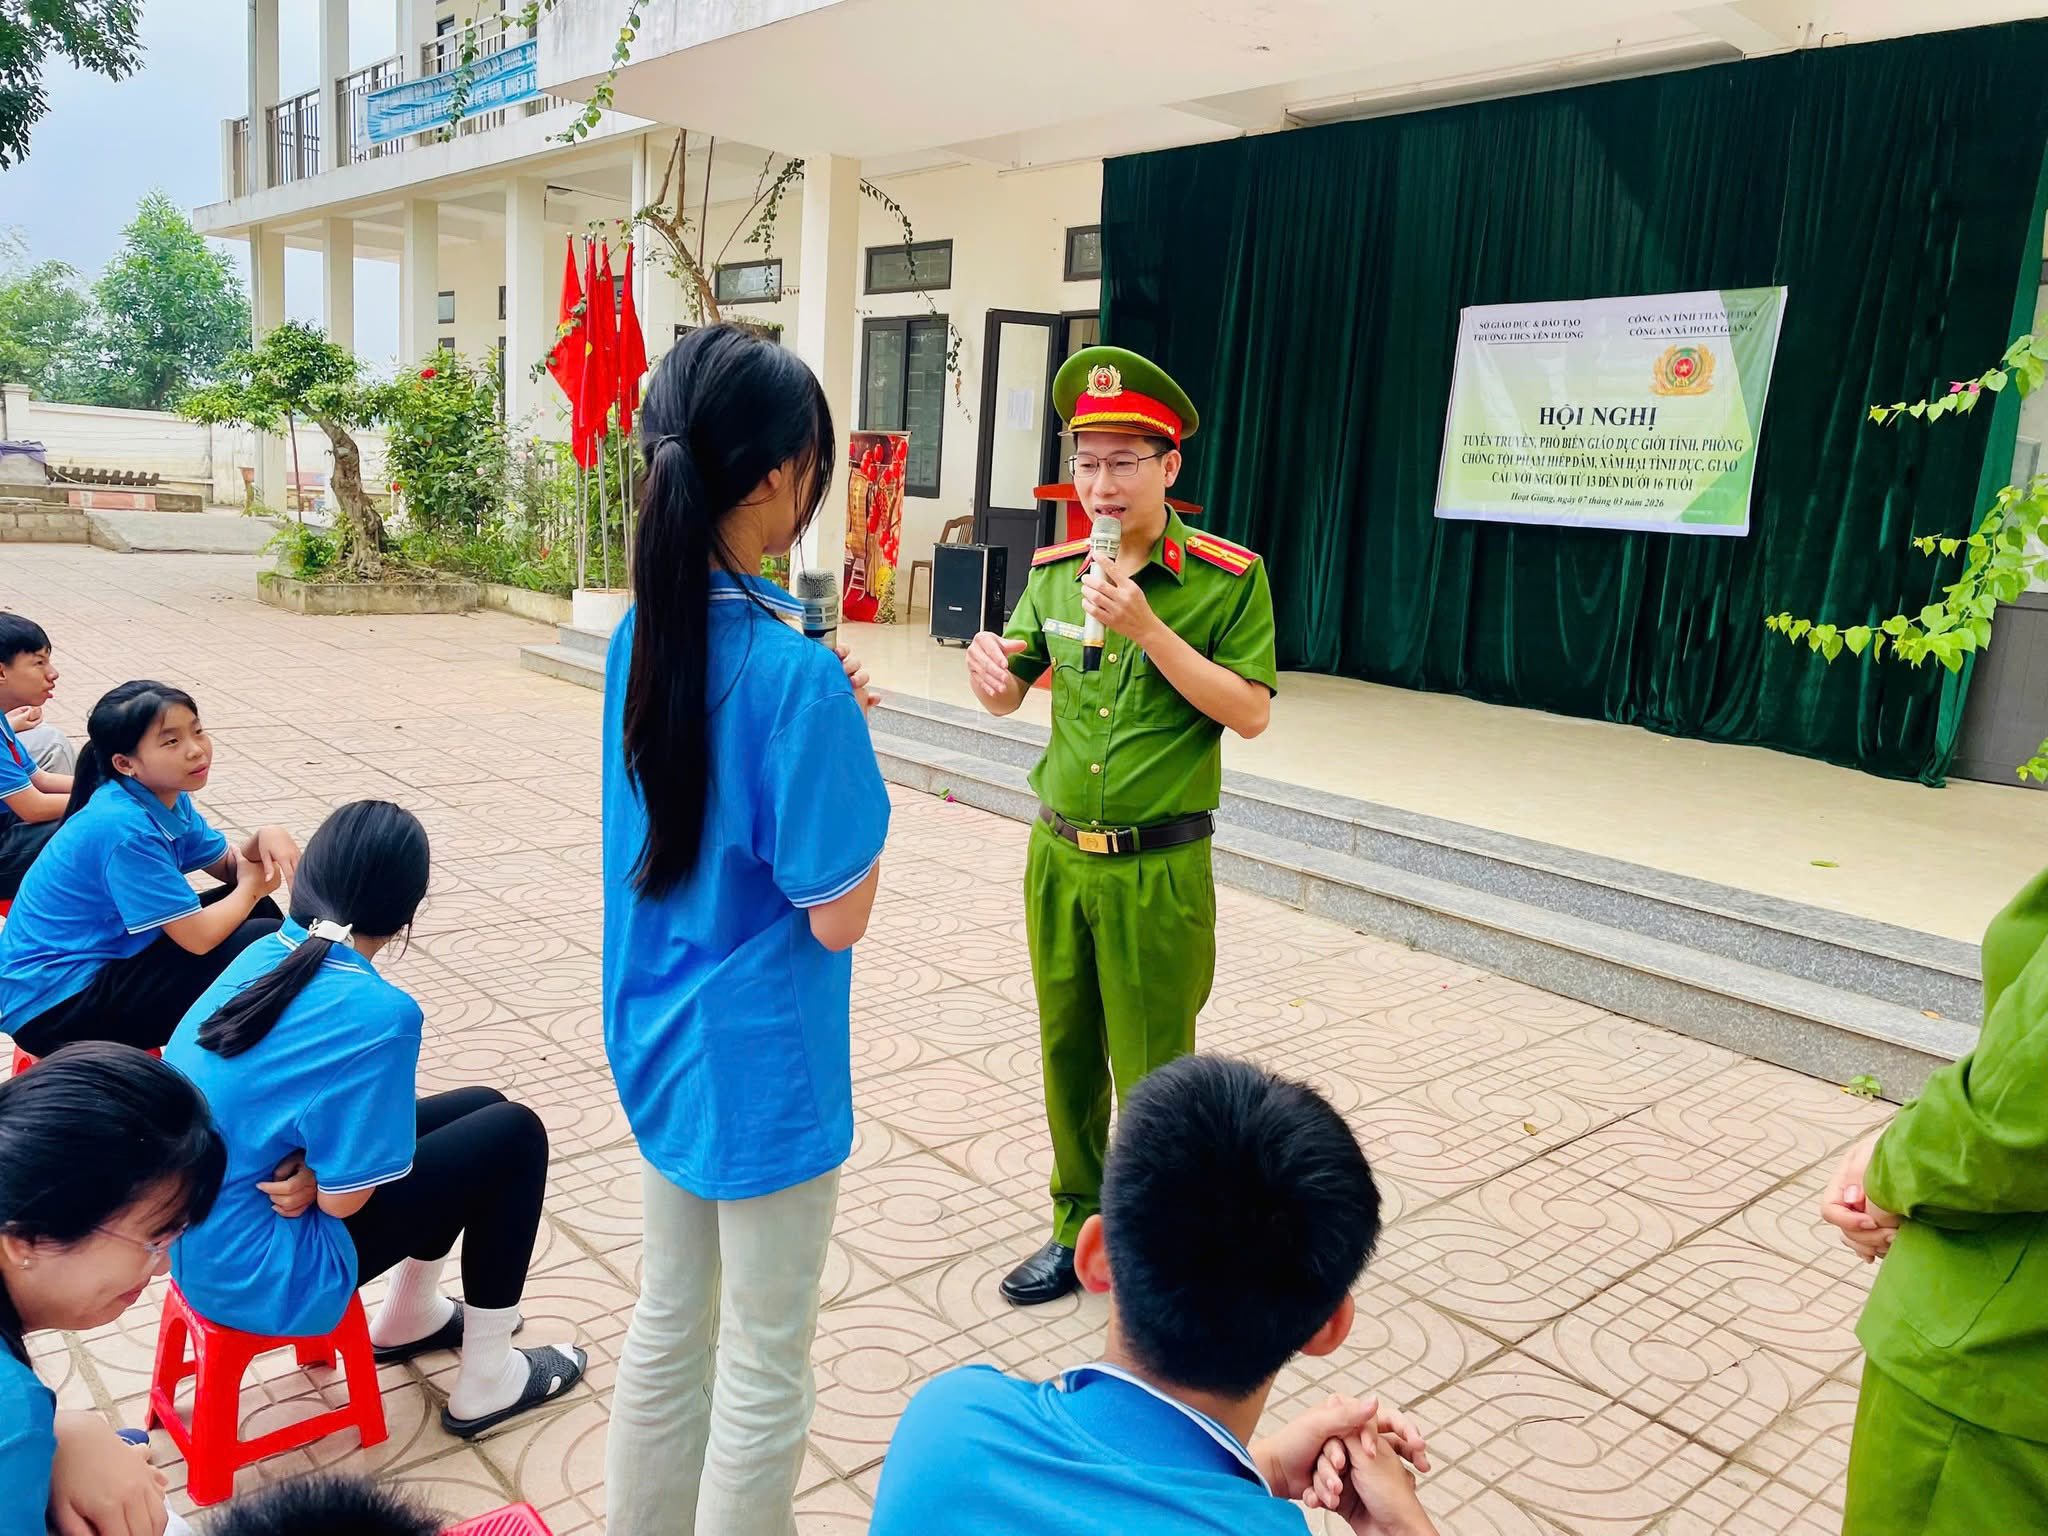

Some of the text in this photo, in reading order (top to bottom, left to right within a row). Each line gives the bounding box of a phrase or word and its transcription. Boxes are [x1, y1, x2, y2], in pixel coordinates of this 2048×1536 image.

[1533, 320, 1539, 328] &
[1659, 314, 1671, 322] AN
[1509, 331, 1531, 340] THCS
[1660, 327, 1672, 335] AN
[1540, 403, 1658, 432] HỘI NGHỊ
[1587, 434, 1614, 451] GIÁO
[1616, 437, 1640, 454] DỤC
[1641, 435, 1667, 451] GIỚI
[1702, 435, 1744, 452] PHÒNG
[1496, 450, 1514, 468] TỘI
[1516, 455, 1545, 469] PHẠM
[1600, 453, 1625, 470] XÂM
[1626, 457, 1647, 473] HẠI
[1649, 454, 1677, 471] TÌNH
[1679, 458, 1705, 475] DỤC,
[1708, 458, 1739, 473] GIAO
[1514, 470, 1532, 485] VỚI
[1534, 471, 1567, 486] NGƯỜI
[1569, 470, 1586, 487] TỪ
[1586, 475, 1597, 487] 13
[1622, 474, 1650, 489] DƯỚI
[1653, 478, 1664, 490] 16
[1511, 492, 1665, 508] Hoạt Giang, ngày 07 tháng 03 năm 2026
